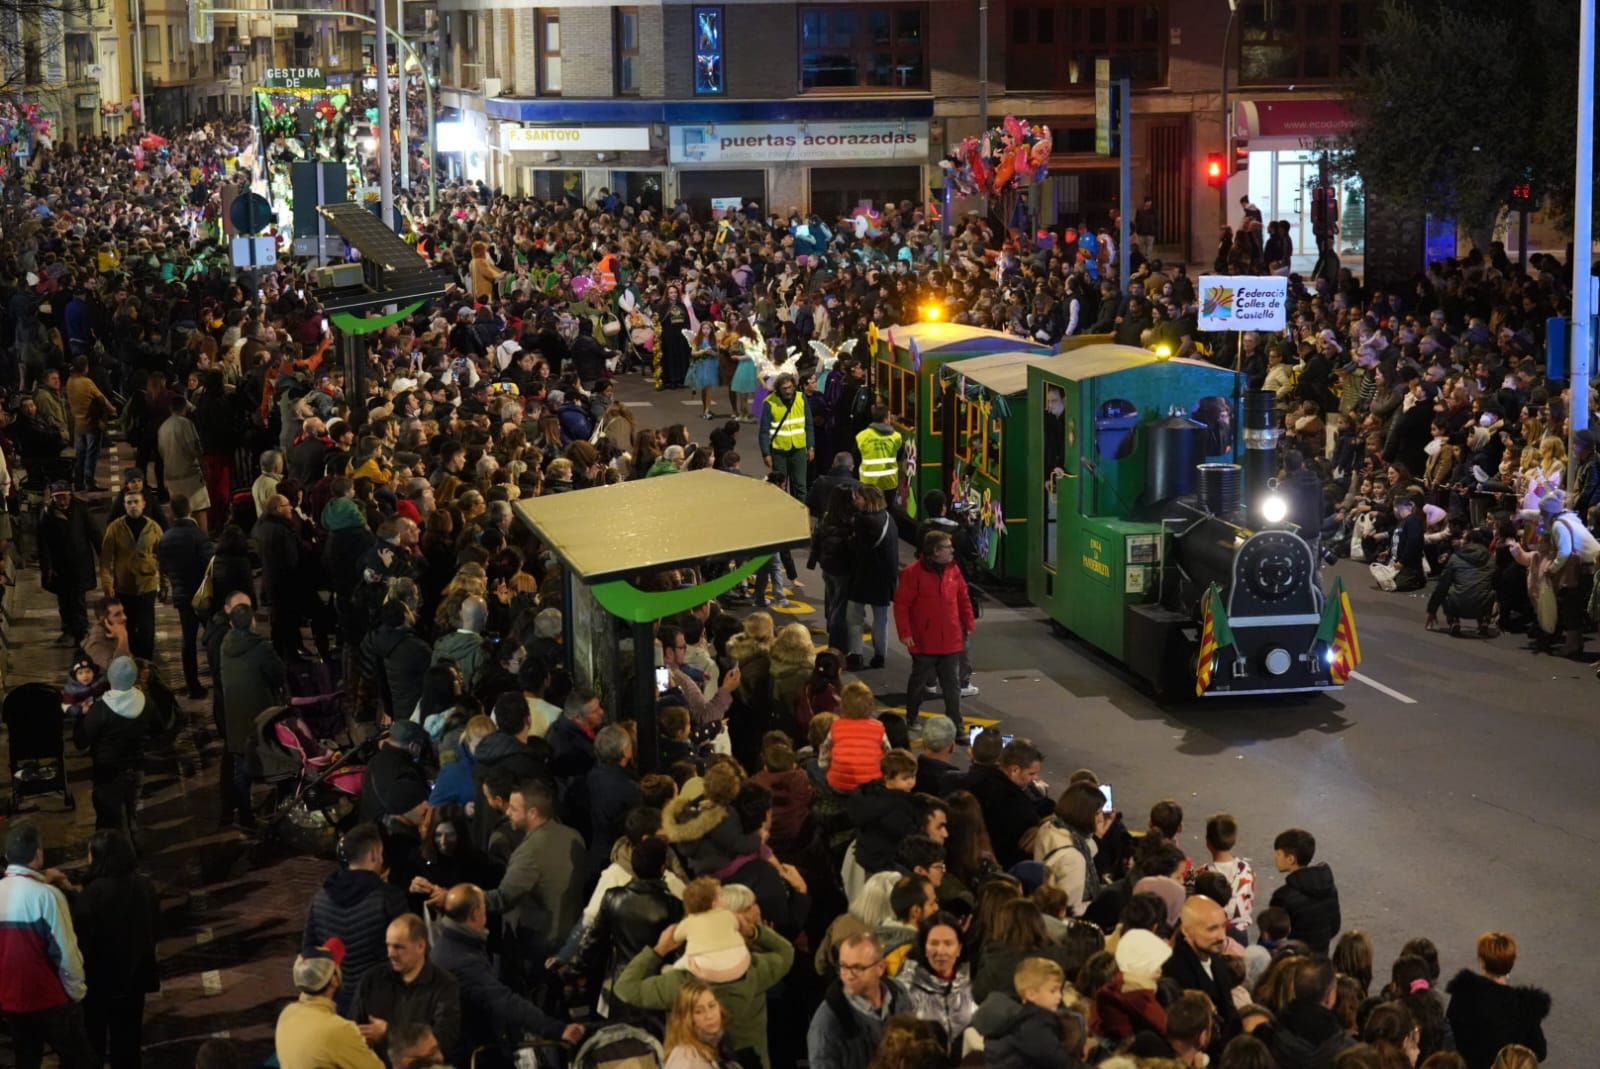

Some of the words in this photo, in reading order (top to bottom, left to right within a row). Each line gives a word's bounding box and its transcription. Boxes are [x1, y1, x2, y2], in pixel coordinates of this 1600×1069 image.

[267, 68, 321, 78] GESTORA
[286, 78, 301, 88] DE
[526, 129, 580, 141] SANTOYO
[720, 134, 797, 150] puertas
[803, 131, 917, 146] acorazadas
[1237, 287, 1285, 298] Federació
[1236, 298, 1266, 308] Colles
[1268, 298, 1281, 308] de
[1264, 412, 1269, 426] 1
